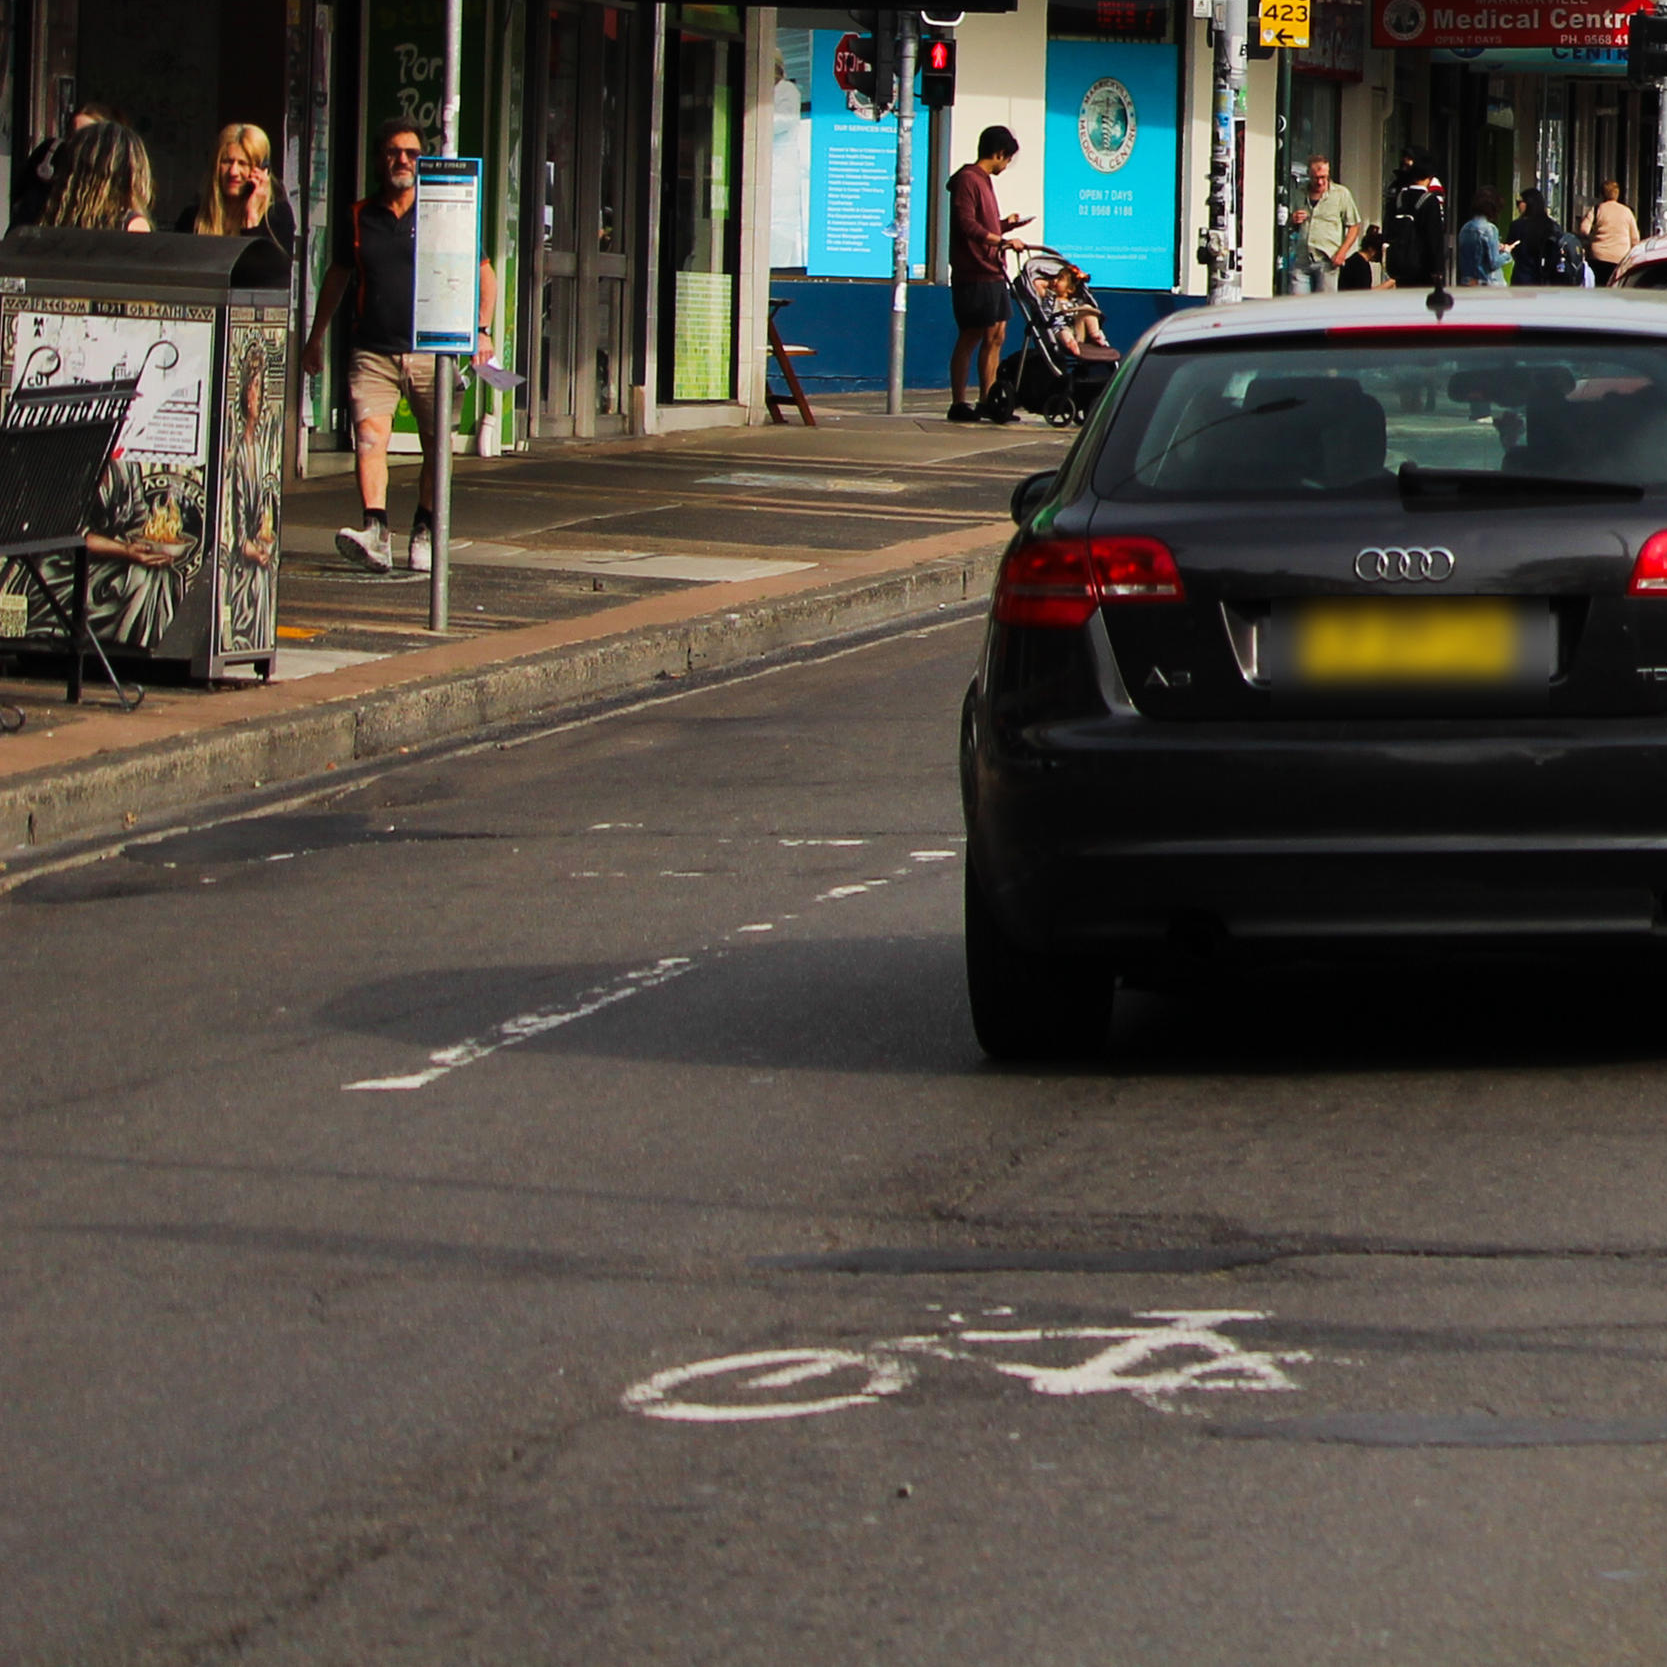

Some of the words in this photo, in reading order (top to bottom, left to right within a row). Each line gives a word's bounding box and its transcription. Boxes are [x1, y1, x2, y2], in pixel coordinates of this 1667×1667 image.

[1263, 5, 1309, 23] 423
[1431, 8, 1540, 31] Medical
[1549, 7, 1630, 31] Centr
[1084, 77, 1133, 109] MARRICKVILLE
[1080, 118, 1105, 169] MEDICAL
[1108, 124, 1137, 170] CENTRE
[1079, 189, 1103, 201] OPEN
[1104, 189, 1109, 201] 7
[1111, 189, 1133, 202] DAYS
[34, 299, 87, 313] FREEDOM
[148, 306, 184, 317] DEATH
[1145, 666, 1191, 687] A3
